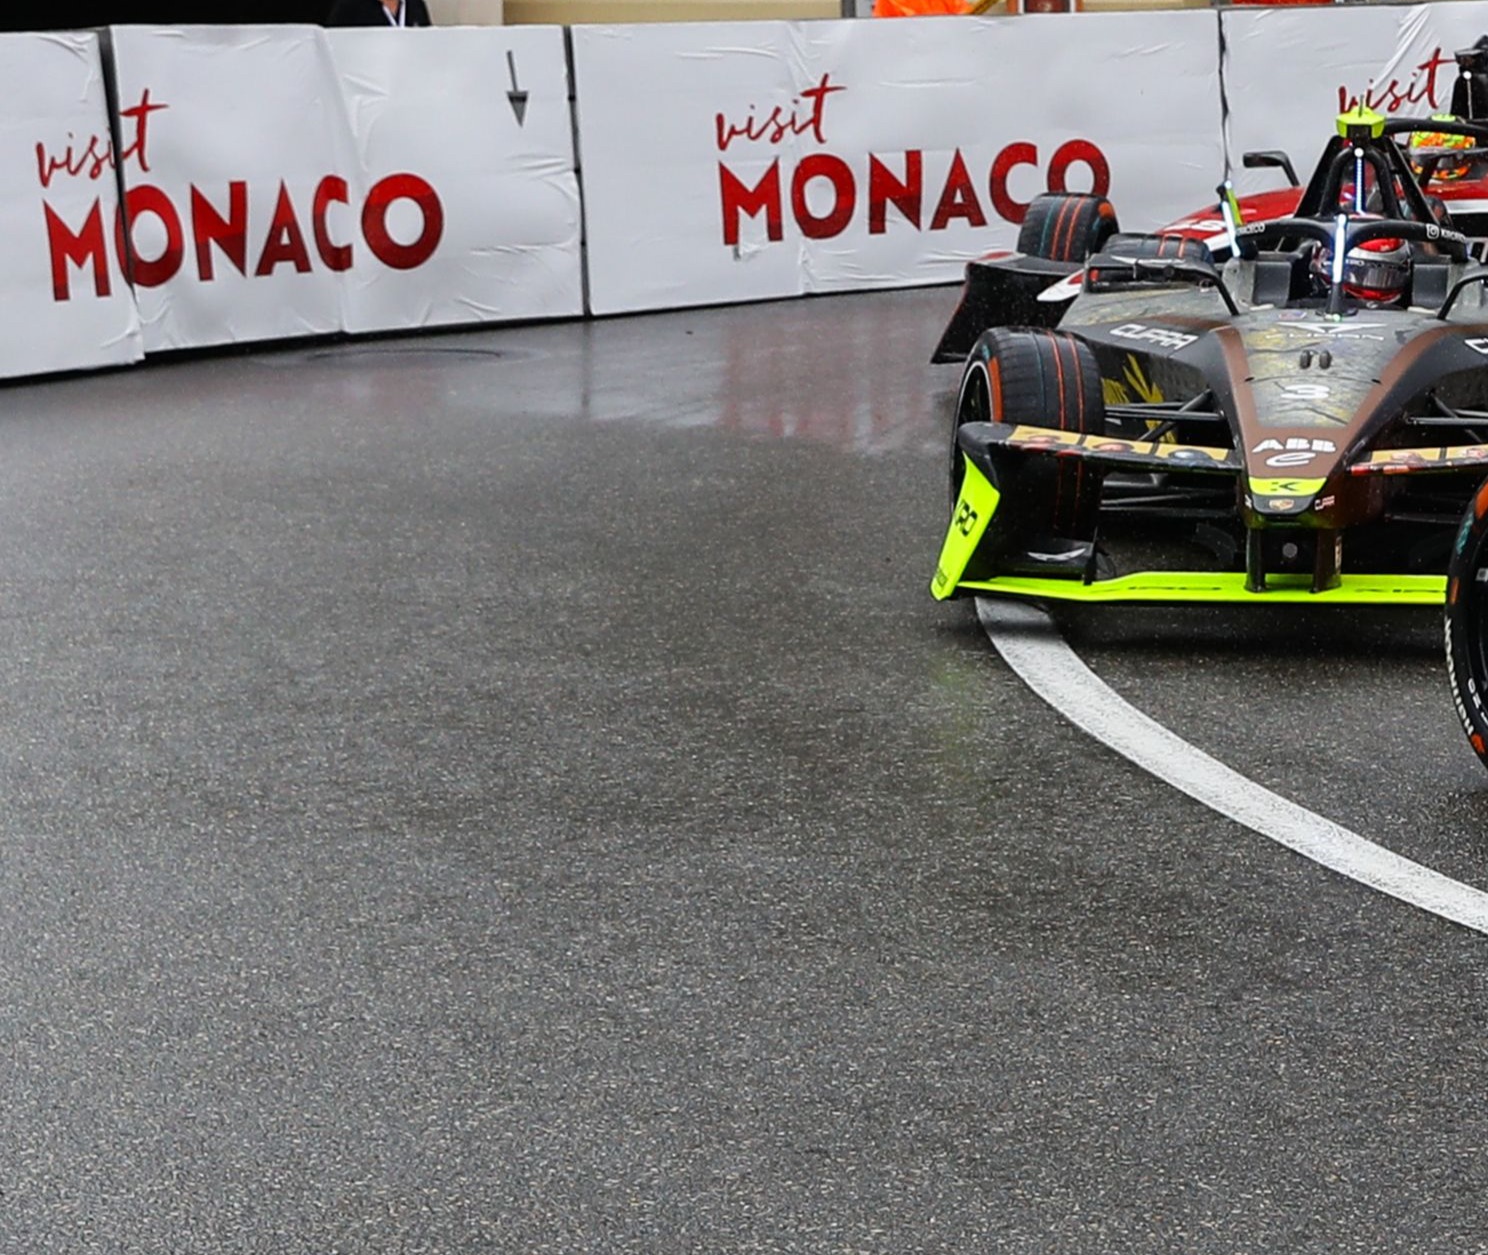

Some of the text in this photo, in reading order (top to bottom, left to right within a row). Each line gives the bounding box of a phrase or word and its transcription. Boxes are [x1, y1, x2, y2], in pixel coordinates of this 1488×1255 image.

[715, 73, 847, 152] visit
[1338, 47, 1456, 113] visit
[35, 88, 169, 188] visit
[44, 172, 445, 302] MONACO
[1280, 384, 1331, 401] 3
[1251, 437, 1337, 455] ABB
